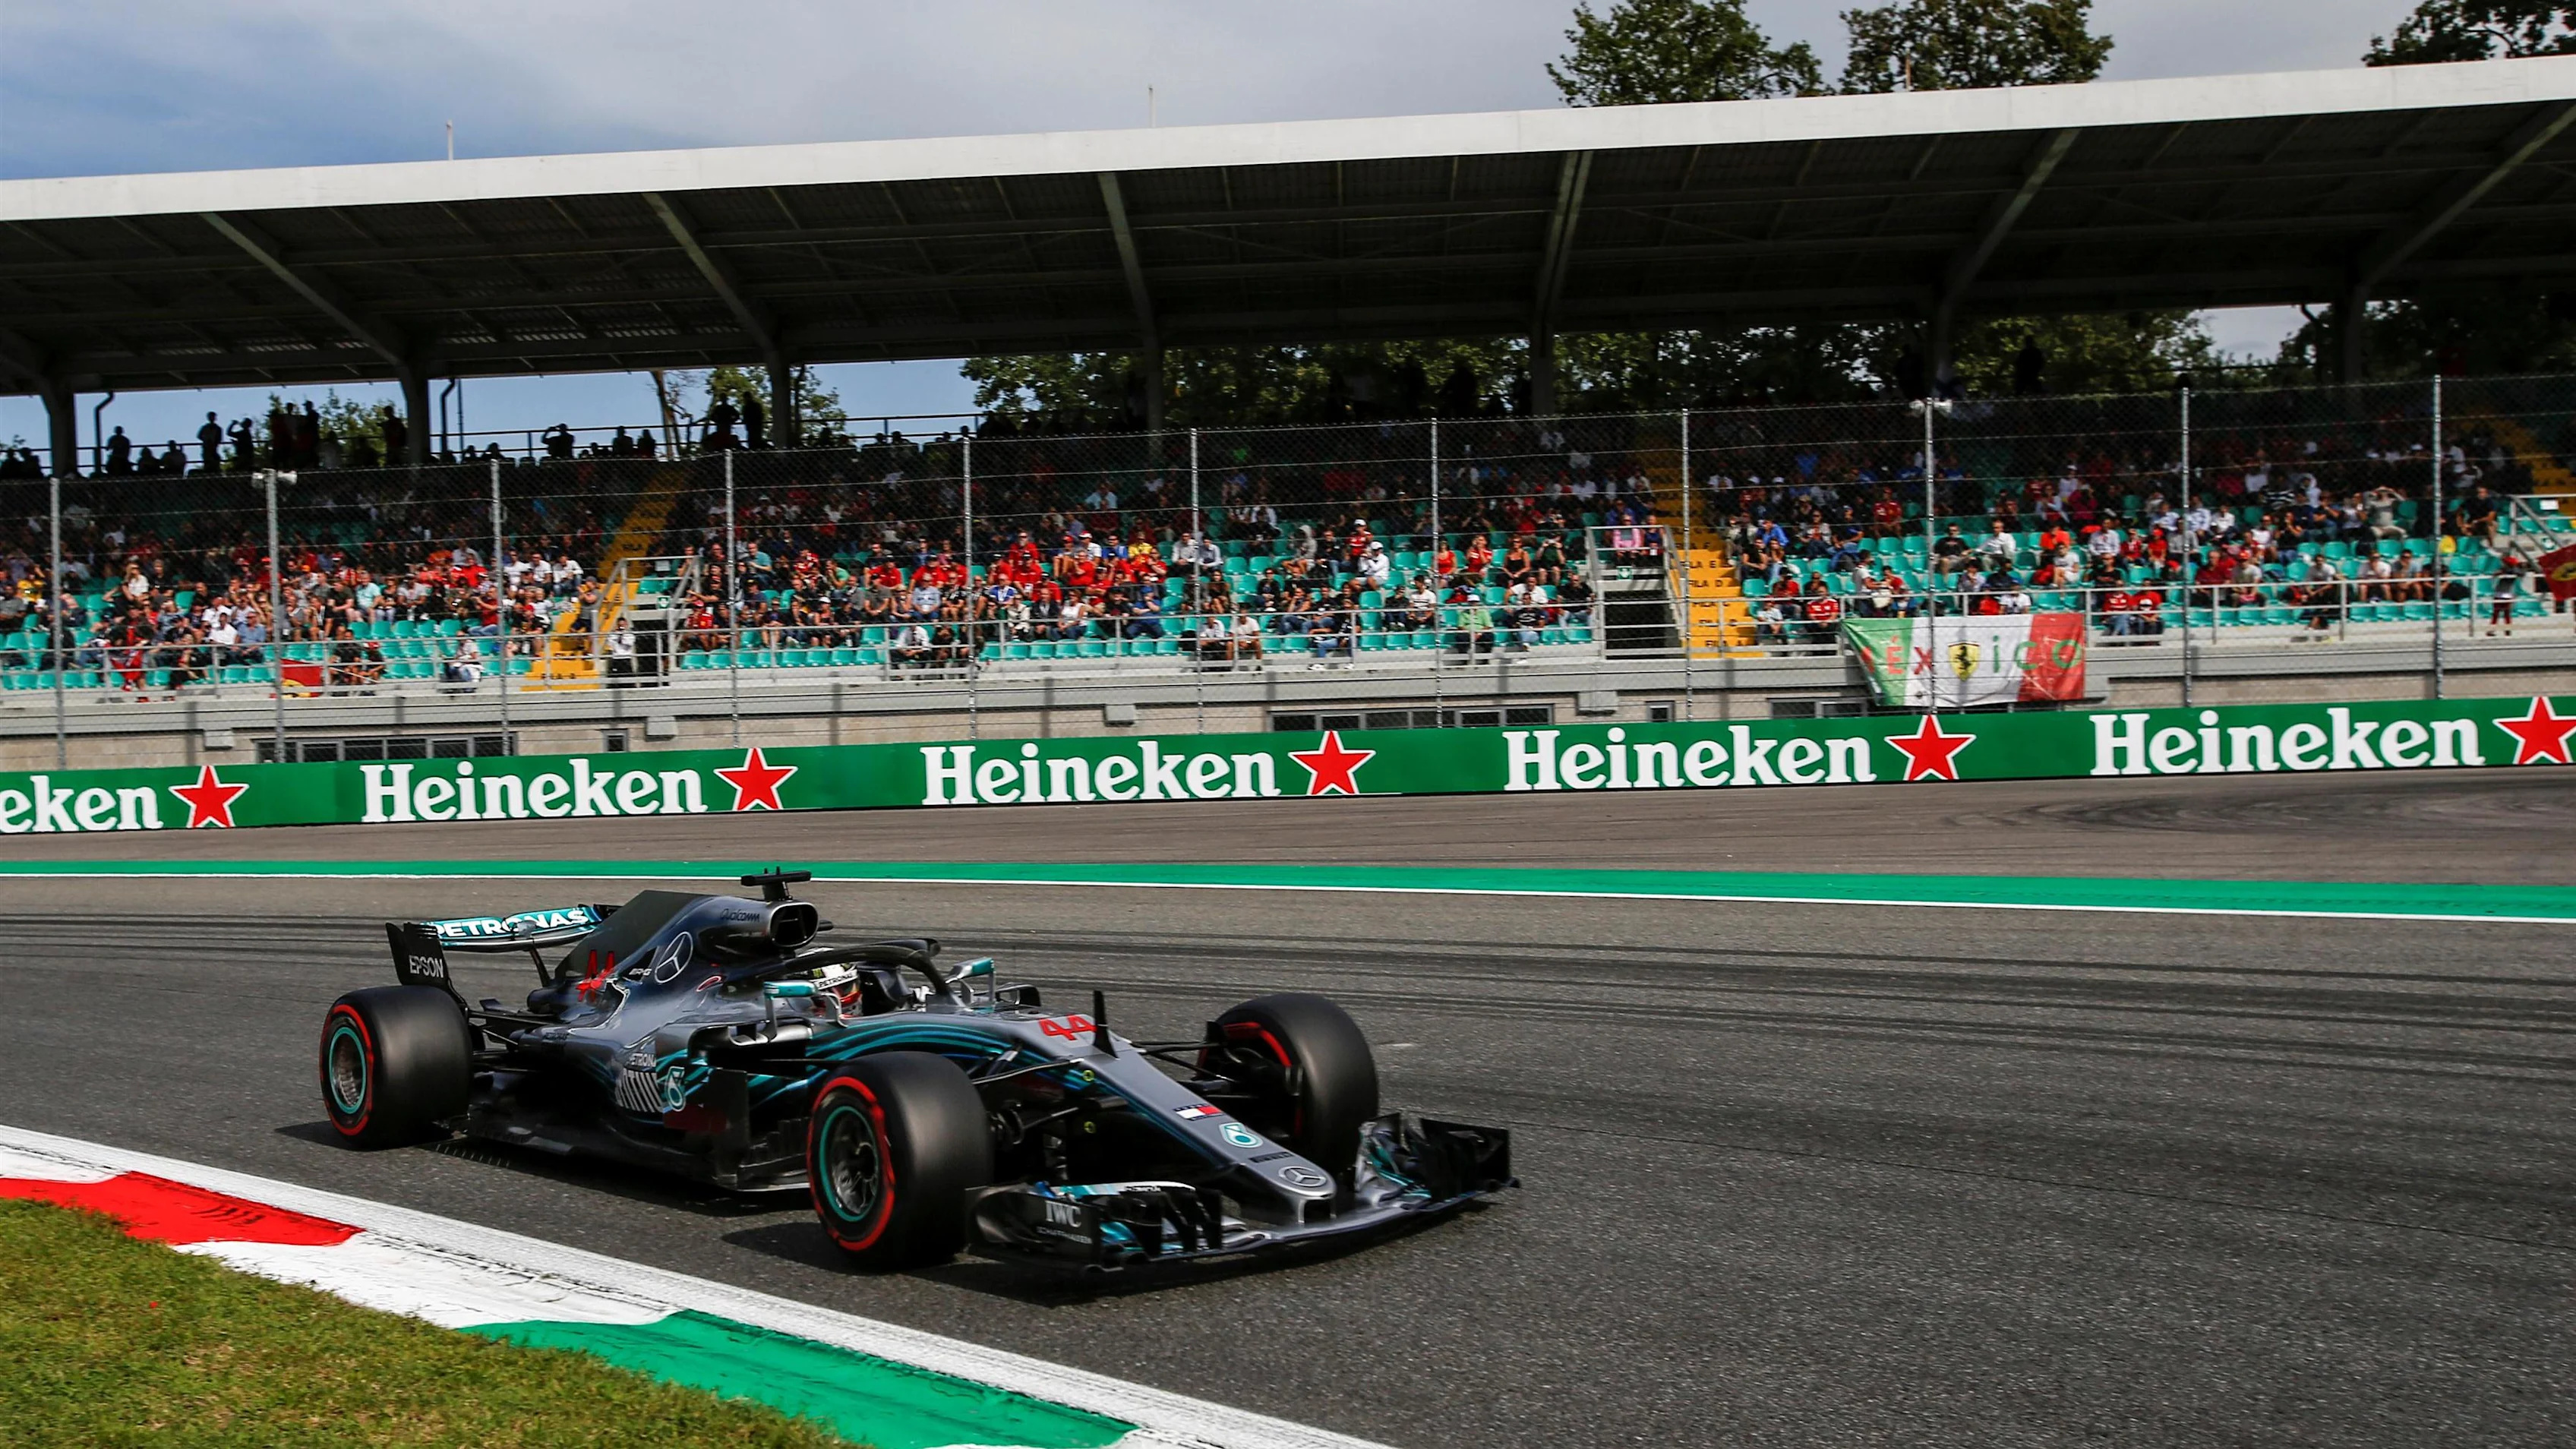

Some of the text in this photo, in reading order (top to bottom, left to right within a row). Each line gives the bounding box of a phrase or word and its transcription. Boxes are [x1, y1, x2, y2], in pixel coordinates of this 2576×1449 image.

[920, 740, 1282, 806] Heineken
[1502, 724, 1877, 791] Heineken
[2089, 707, 2486, 775] Heineken
[359, 758, 709, 822] Heineken
[409, 955, 444, 978] EPSON
[1038, 1014, 1097, 1041] 44
[1044, 1200, 1082, 1228] IWC
